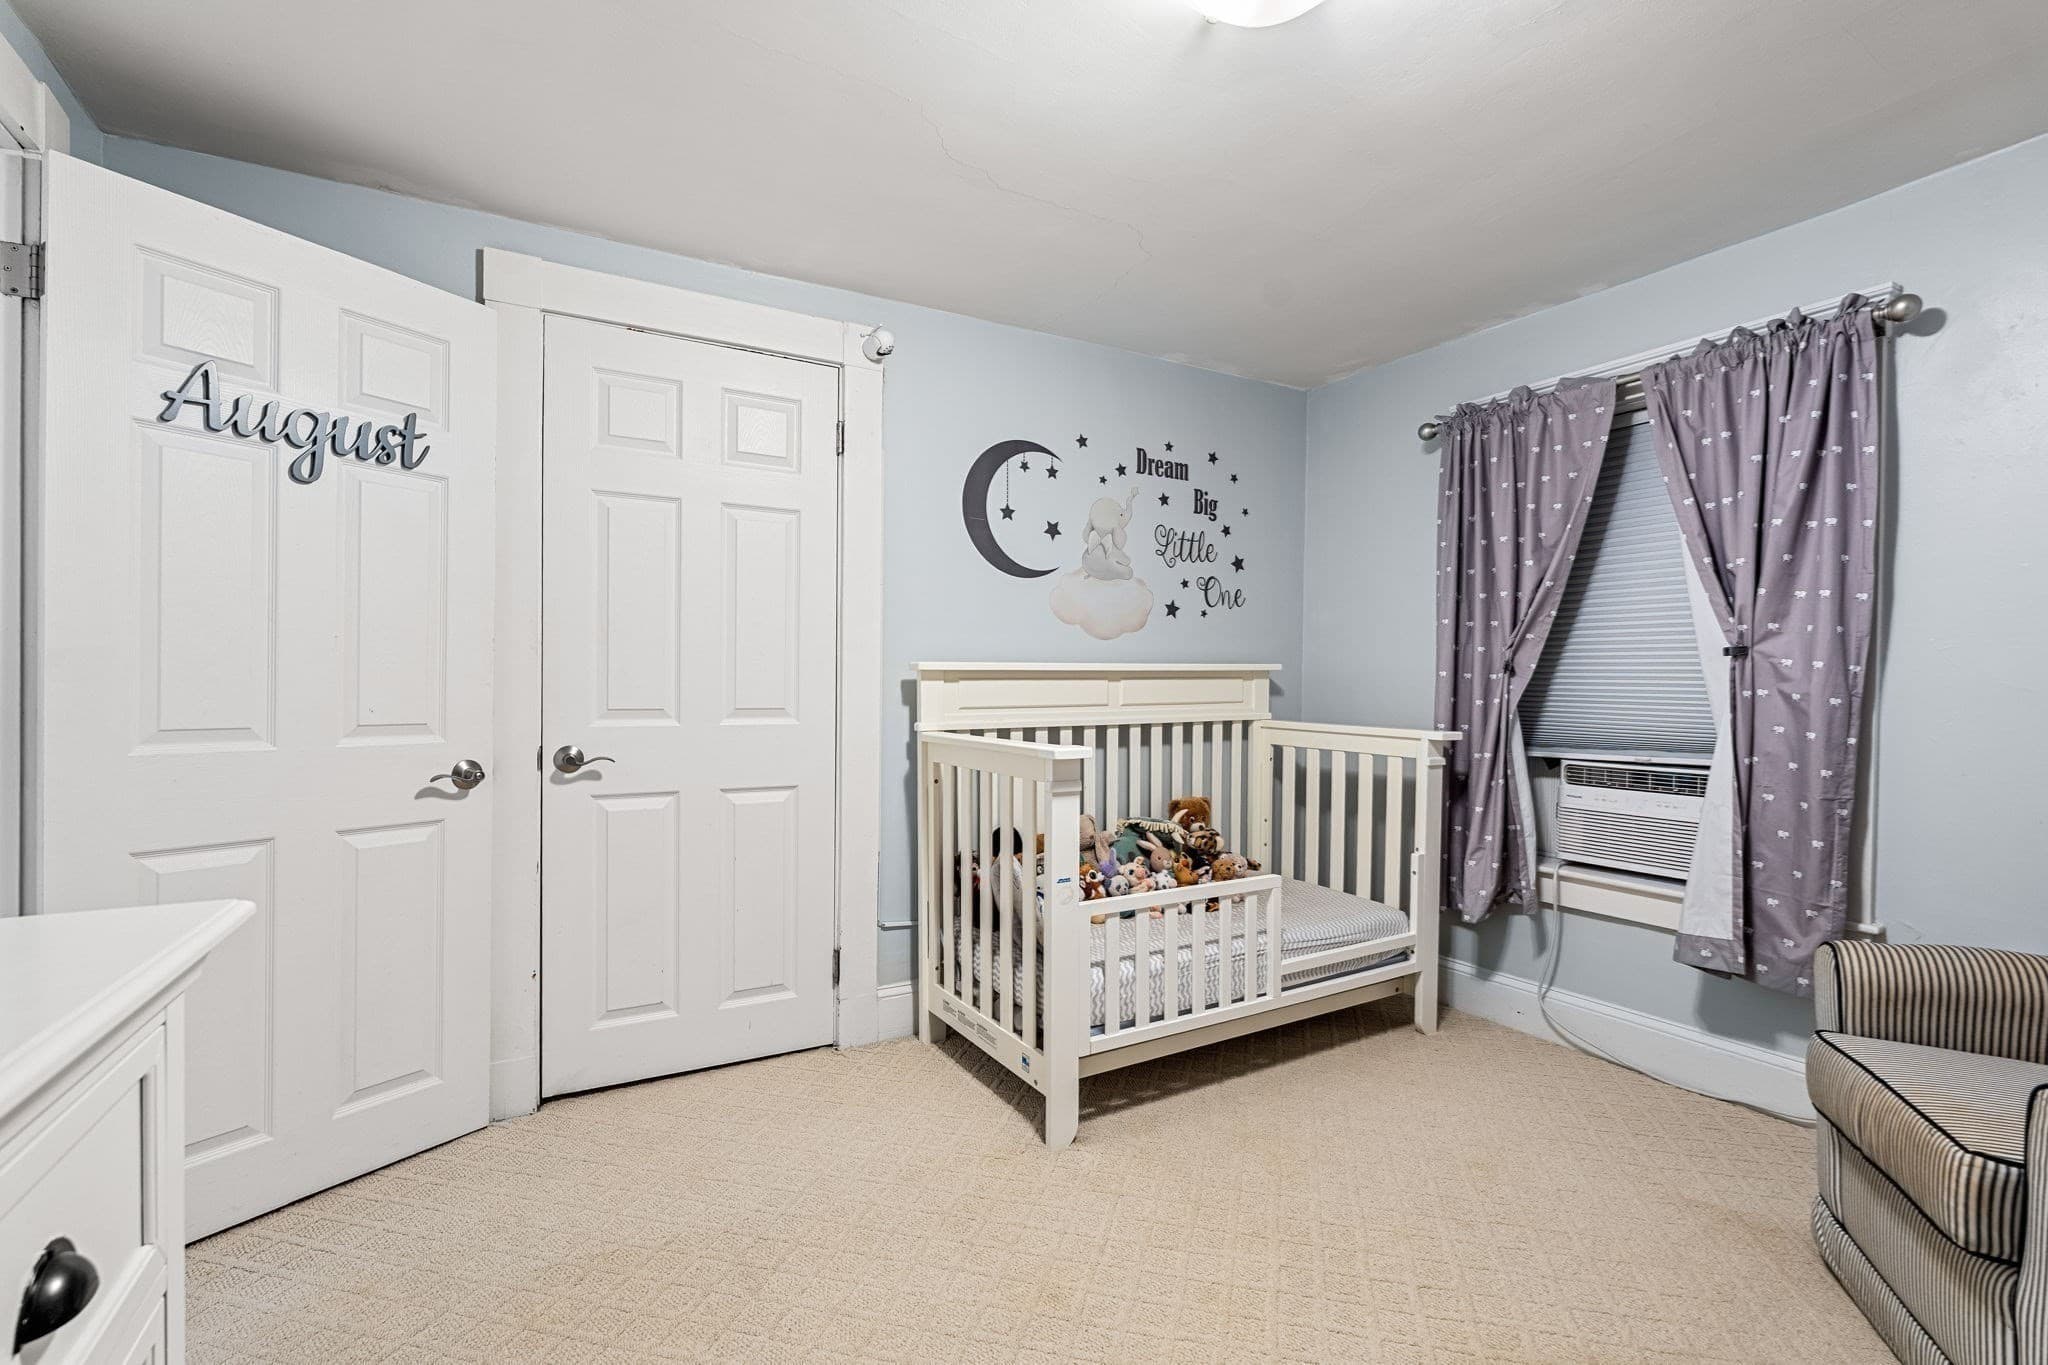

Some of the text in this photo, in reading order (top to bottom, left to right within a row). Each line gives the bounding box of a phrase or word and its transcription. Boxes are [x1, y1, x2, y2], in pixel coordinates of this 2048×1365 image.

[156, 359, 431, 485] August
[1135, 447, 1189, 481] Dream
[1193, 488, 1218, 522] Big
[1154, 524, 1218, 568] Little
[1196, 575, 1246, 610] One
